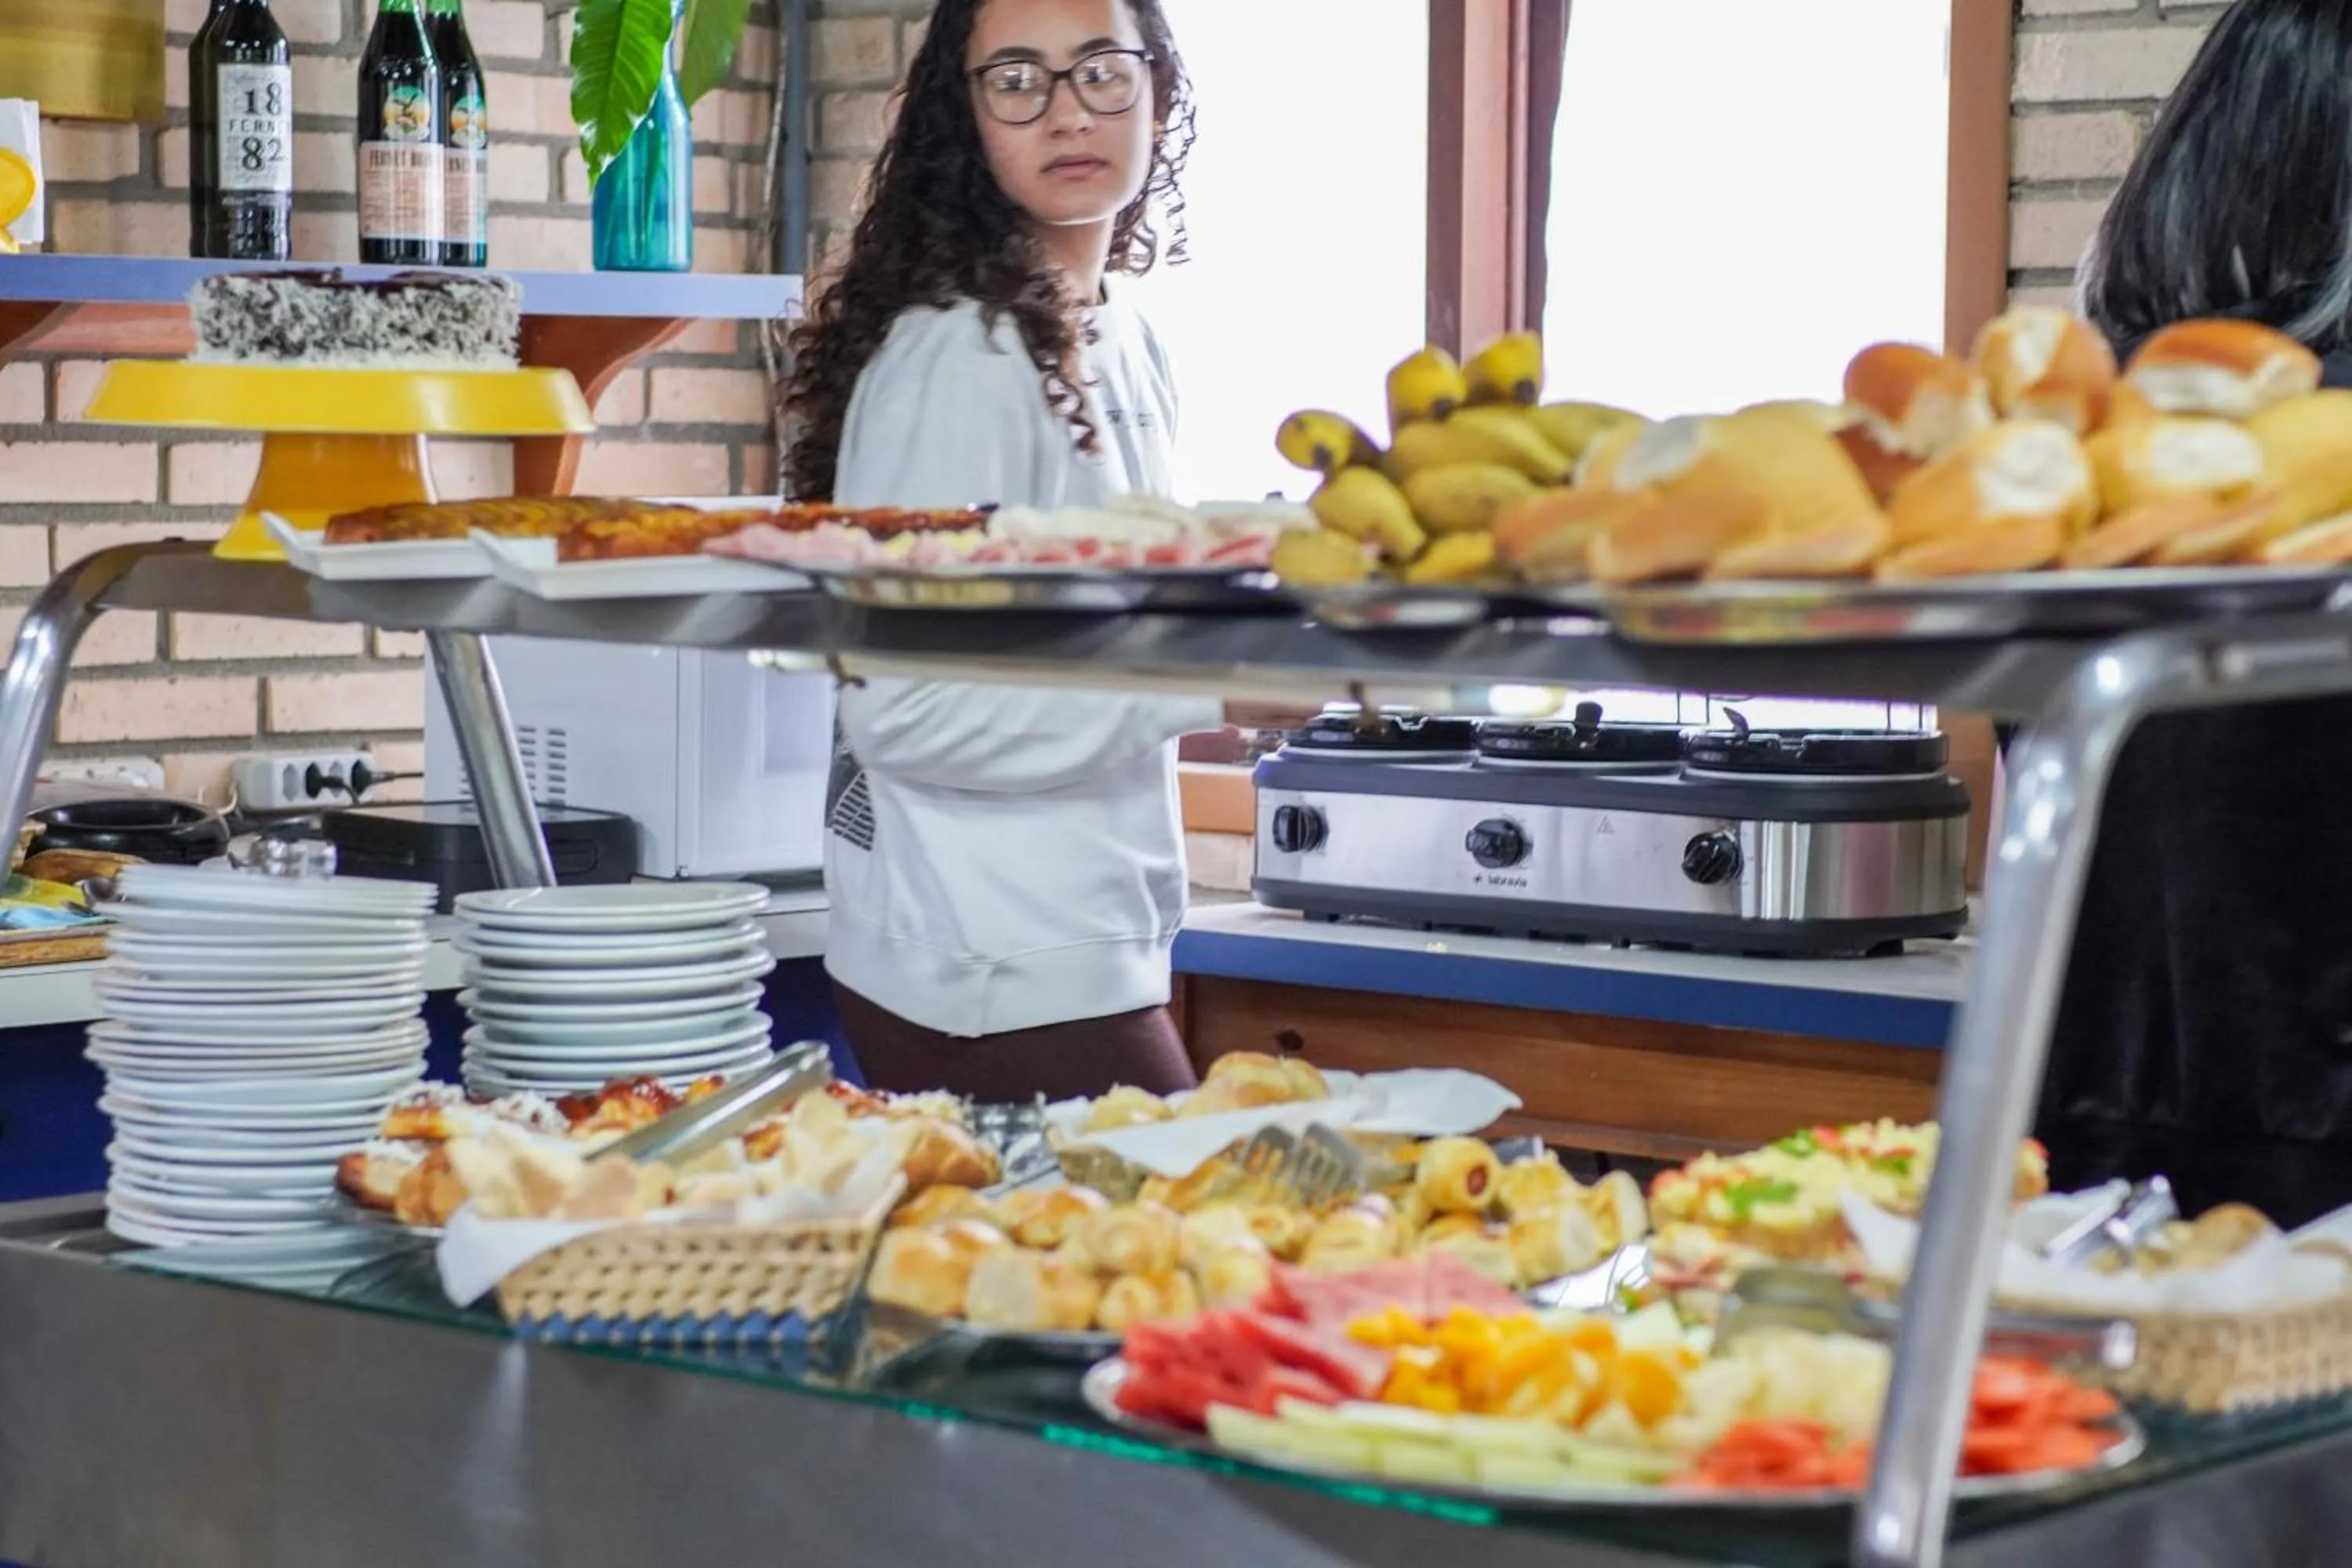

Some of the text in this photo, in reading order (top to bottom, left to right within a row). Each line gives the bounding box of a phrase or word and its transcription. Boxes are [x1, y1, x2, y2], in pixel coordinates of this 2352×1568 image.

[244, 82, 282, 115] 18
[229, 119, 287, 132] FERN
[242, 136, 284, 171] 82
